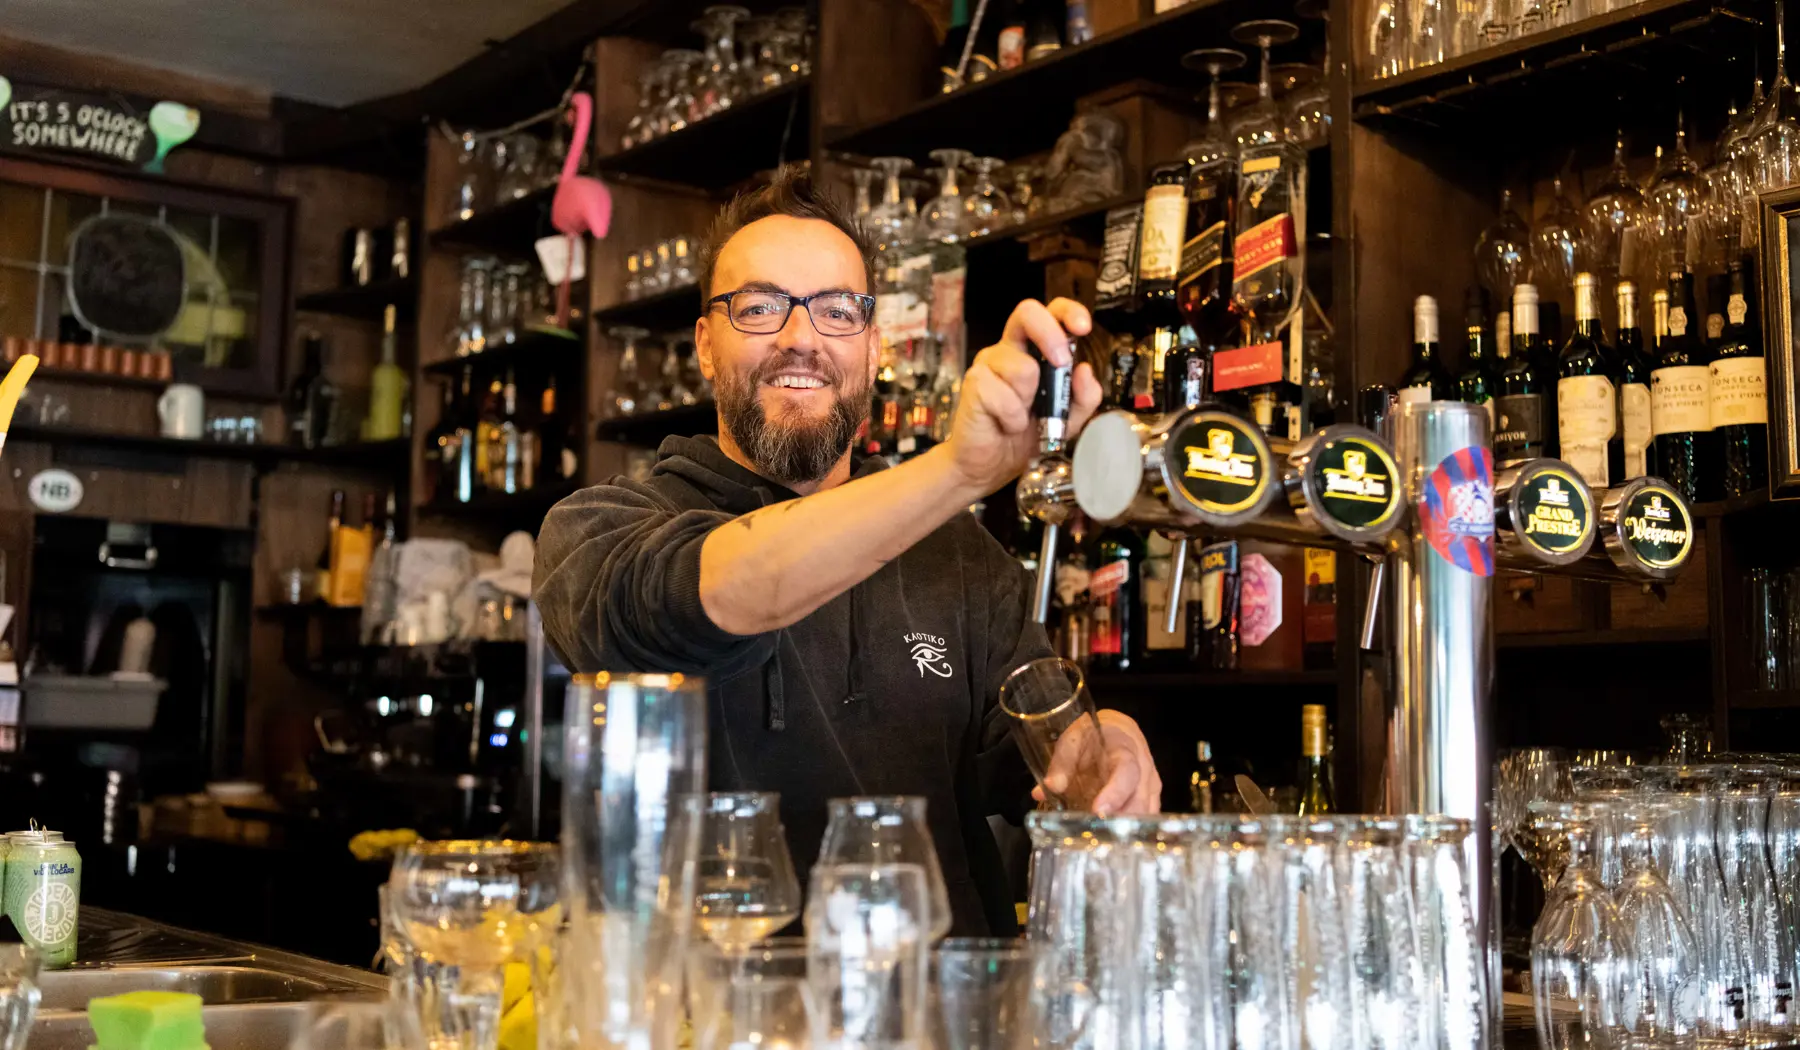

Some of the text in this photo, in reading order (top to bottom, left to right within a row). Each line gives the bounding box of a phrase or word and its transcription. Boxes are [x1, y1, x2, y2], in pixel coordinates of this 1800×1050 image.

[12, 121, 142, 162] SOMEWHERE
[1534, 505, 1575, 522] GRAND
[1524, 514, 1583, 537] PRESTIGE
[1624, 516, 1687, 546] Weizener
[903, 632, 945, 646] KAOTIKO
